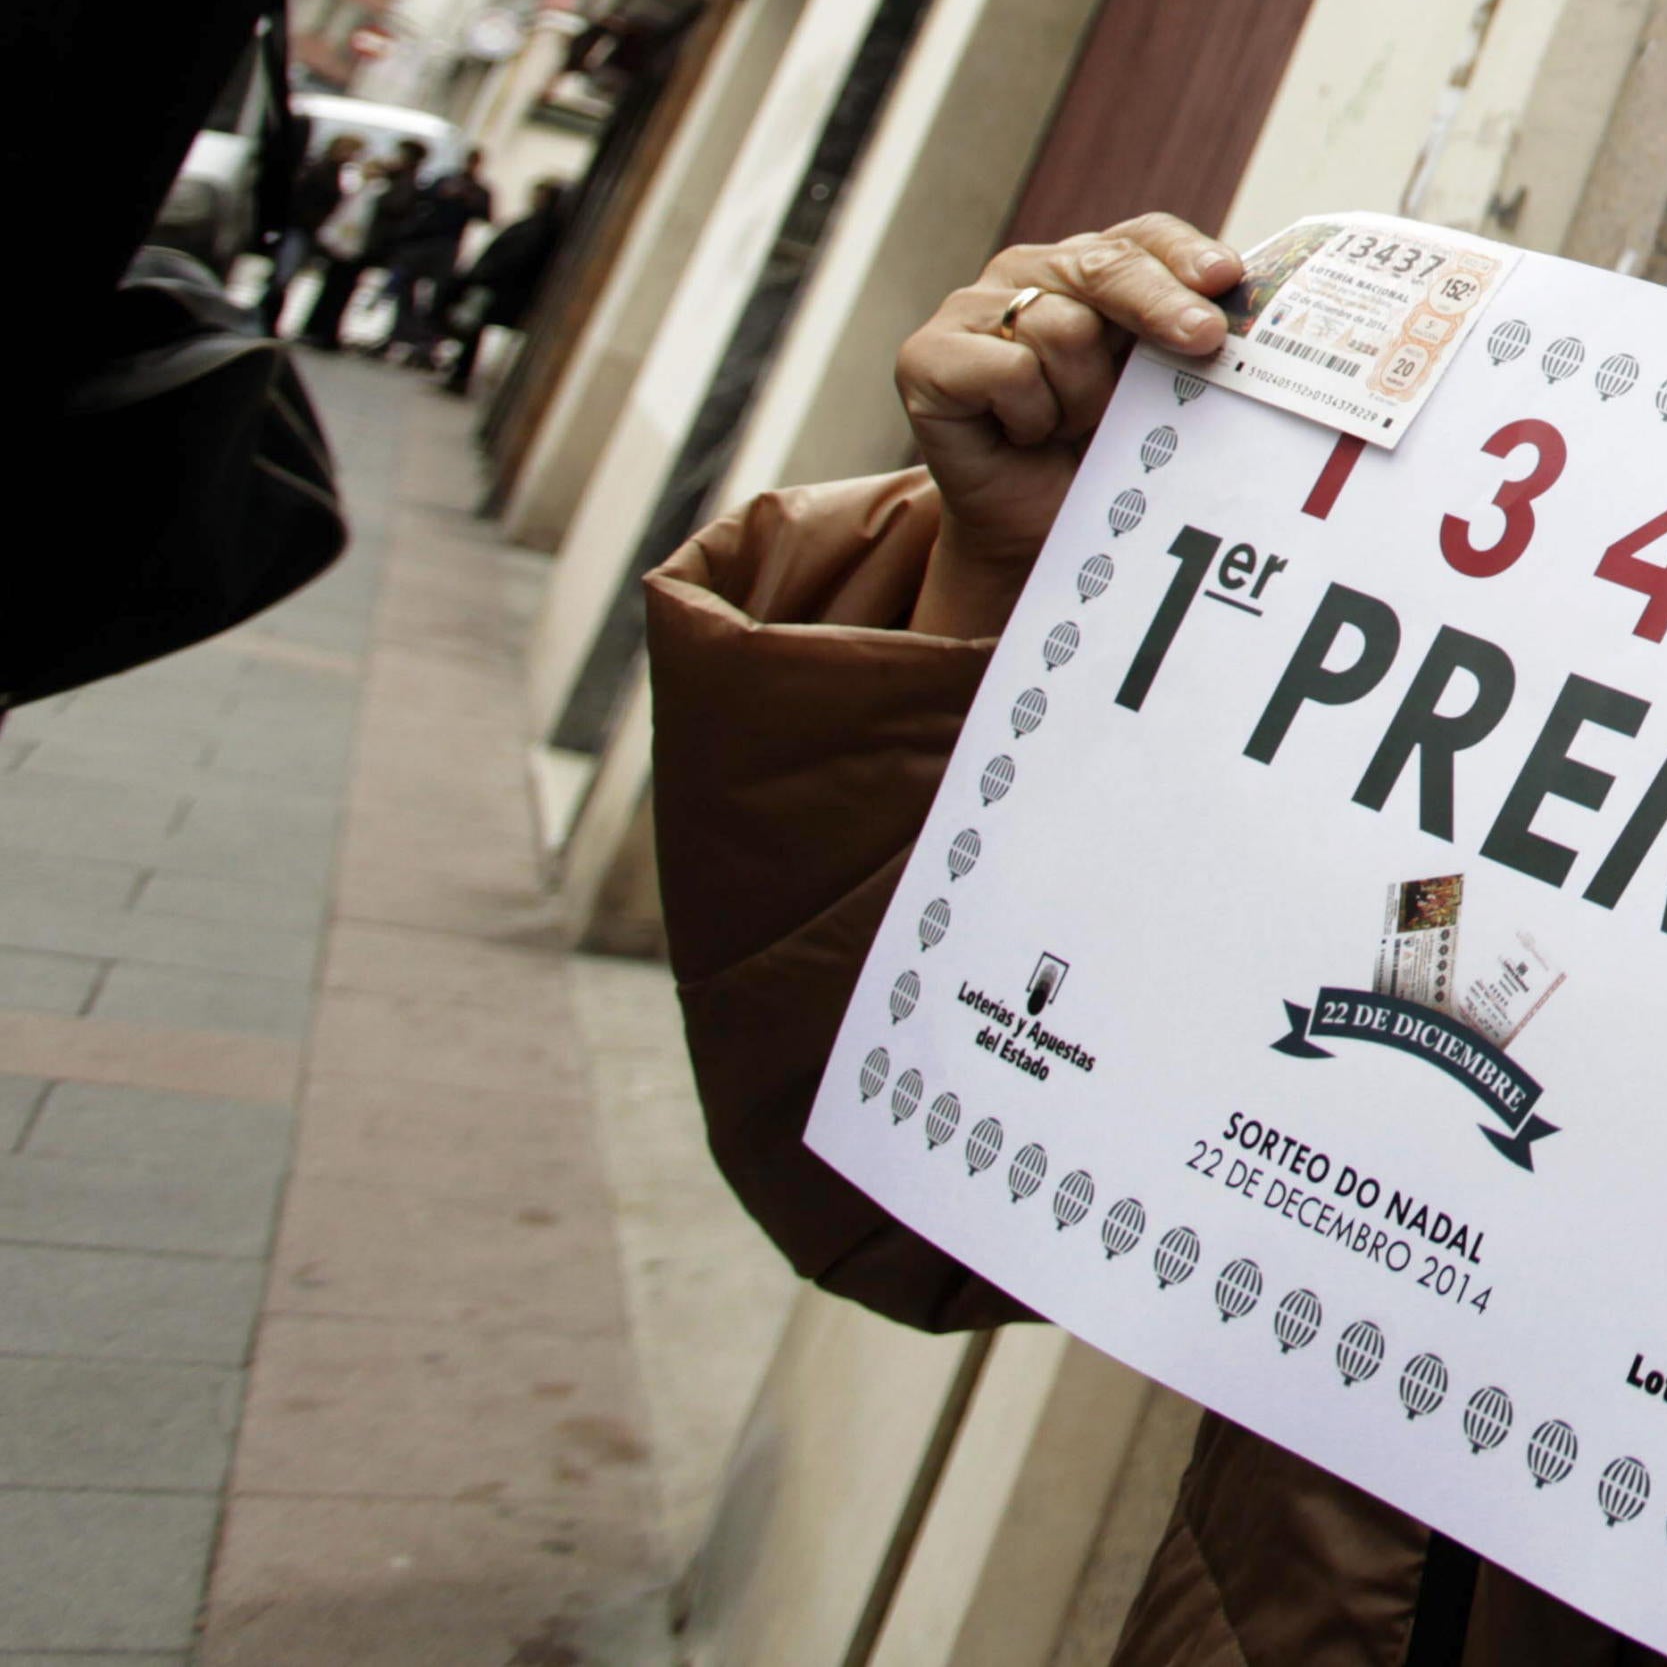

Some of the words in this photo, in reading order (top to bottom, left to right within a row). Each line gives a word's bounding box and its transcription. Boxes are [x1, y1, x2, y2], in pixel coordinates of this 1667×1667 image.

[1336, 233, 1446, 278] 13437
[1392, 357, 1416, 377] 20
[1114, 524, 1287, 712] 1er
[957, 979, 1015, 1028] Loterías
[1012, 1016, 1028, 1039] y
[1026, 1020, 1097, 1072] Apuestas
[975, 1025, 1002, 1053] del
[999, 1038, 1050, 1082] Estado
[1321, 1001, 1349, 1024] 22
[1352, 1003, 1391, 1031] DE
[1392, 1012, 1527, 1113] DICIEMBRE
[1185, 1139, 1224, 1178] 22
[1224, 1158, 1265, 1199] DE
[1263, 1177, 1412, 1272] DECEMBRO
[1416, 1254, 1494, 1316] 2014
[1222, 1111, 1331, 1184] SORTEO
[1334, 1165, 1381, 1209] DO
[1383, 1190, 1485, 1265] NADAL
